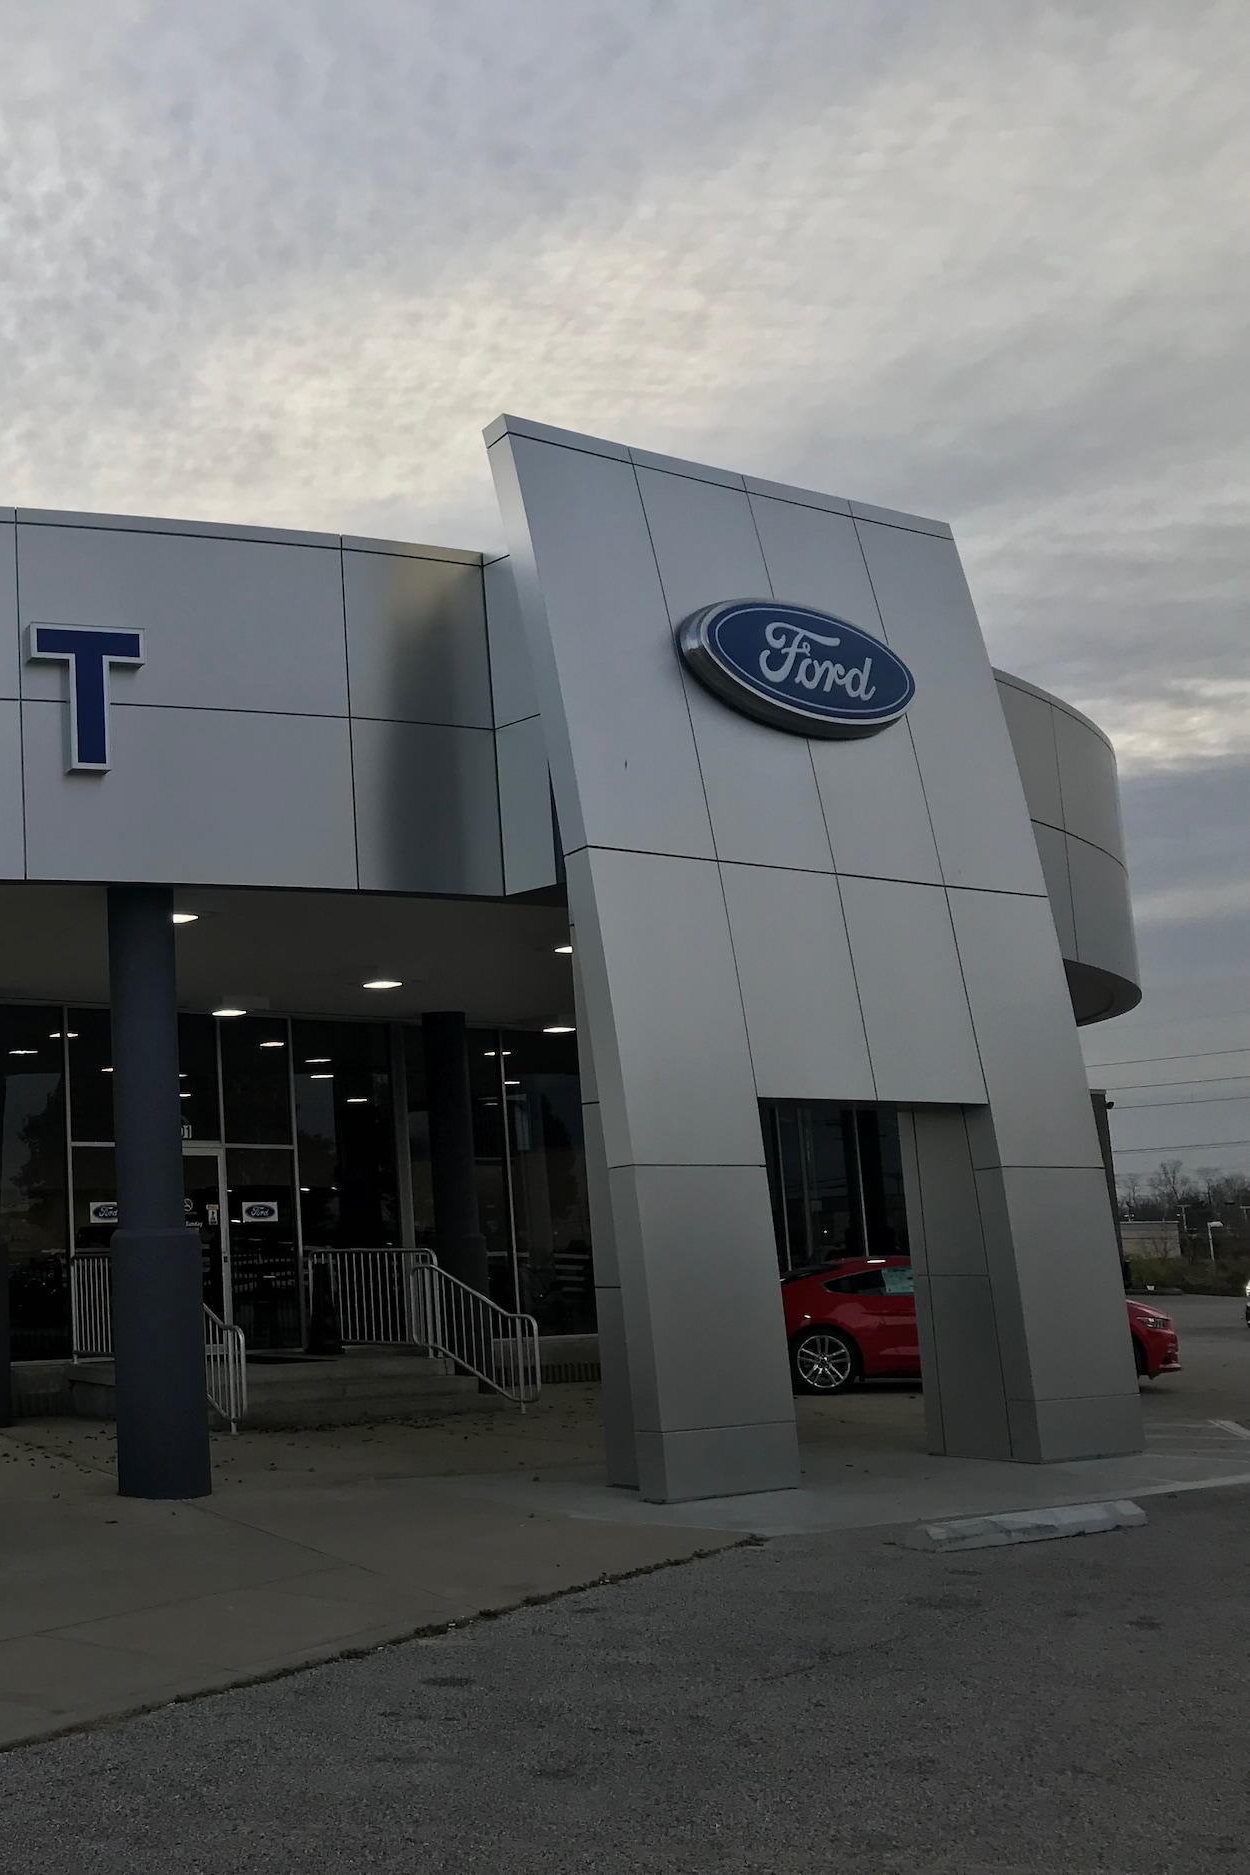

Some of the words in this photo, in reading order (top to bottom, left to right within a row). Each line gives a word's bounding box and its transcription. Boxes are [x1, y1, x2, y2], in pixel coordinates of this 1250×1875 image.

[758, 621, 877, 701] Ford
[98, 1203, 118, 1217] Ford
[251, 1204, 270, 1216] Ford
